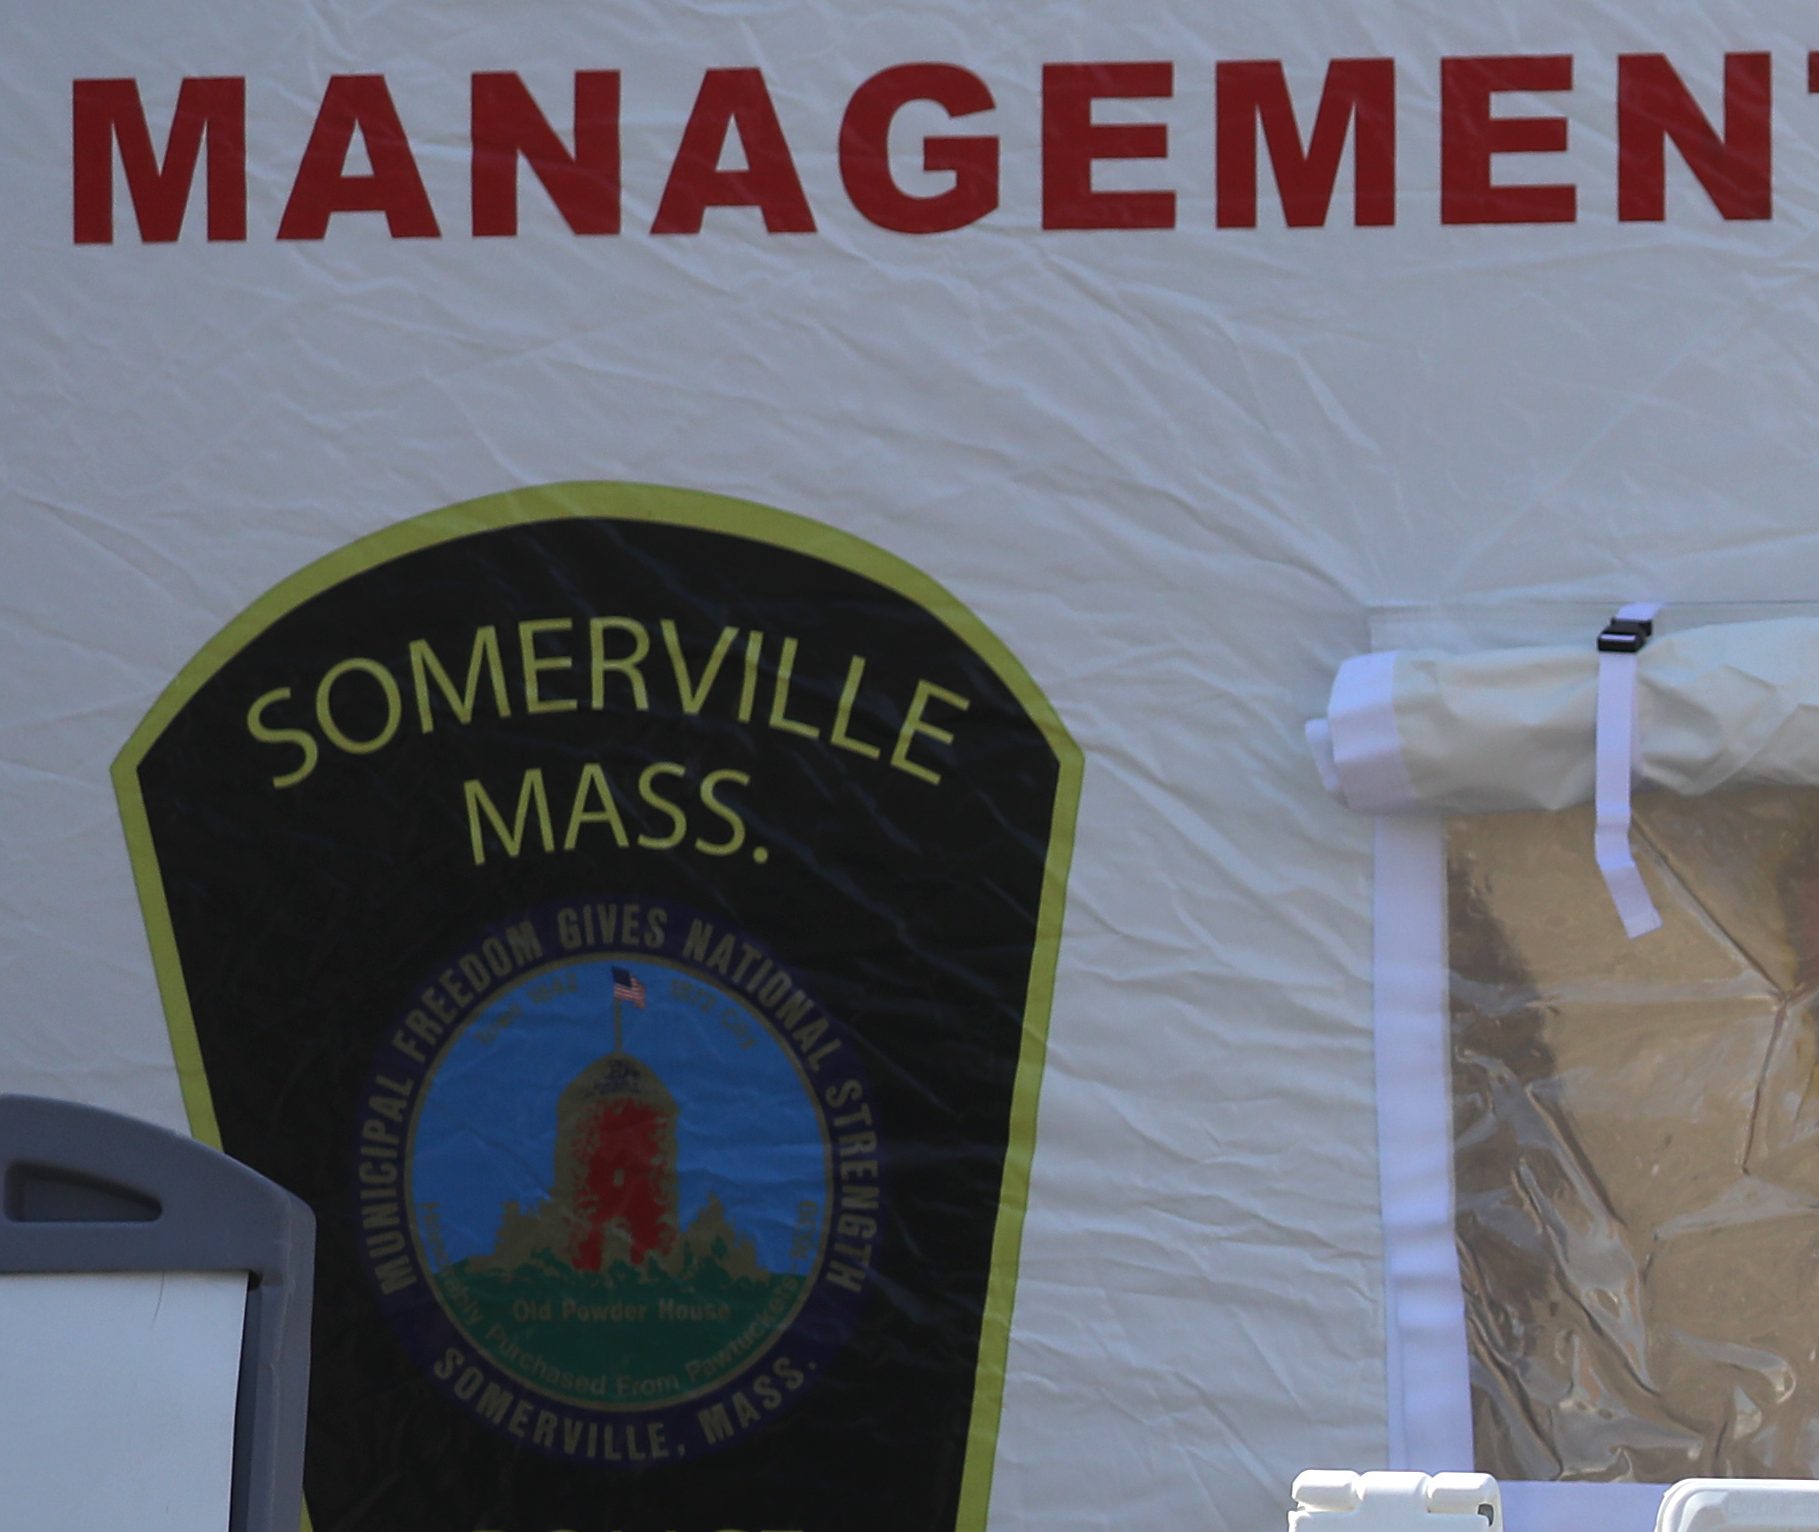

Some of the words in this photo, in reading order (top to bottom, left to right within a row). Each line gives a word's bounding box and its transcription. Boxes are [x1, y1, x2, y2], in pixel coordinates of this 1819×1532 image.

[247, 616, 970, 788] SOMERVILLE
[463, 762, 768, 865] MASS.
[359, 1073, 418, 1297] MUNICIPAL
[391, 918, 544, 1064] FREEDOM
[557, 903, 669, 951] GIVES
[684, 918, 841, 1073] NATIONAL
[824, 1077, 879, 1295] STRENGTH
[484, 1323, 607, 1398] Purchased
[616, 1374, 680, 1398] From
[686, 1275, 800, 1382] Pawtuckets
[512, 1298, 551, 1323] Old
[562, 1298, 645, 1323] Powder
[658, 1298, 730, 1322] House
[434, 1346, 687, 1461] SOMERVILLE,
[698, 1355, 820, 1445] MASS.
